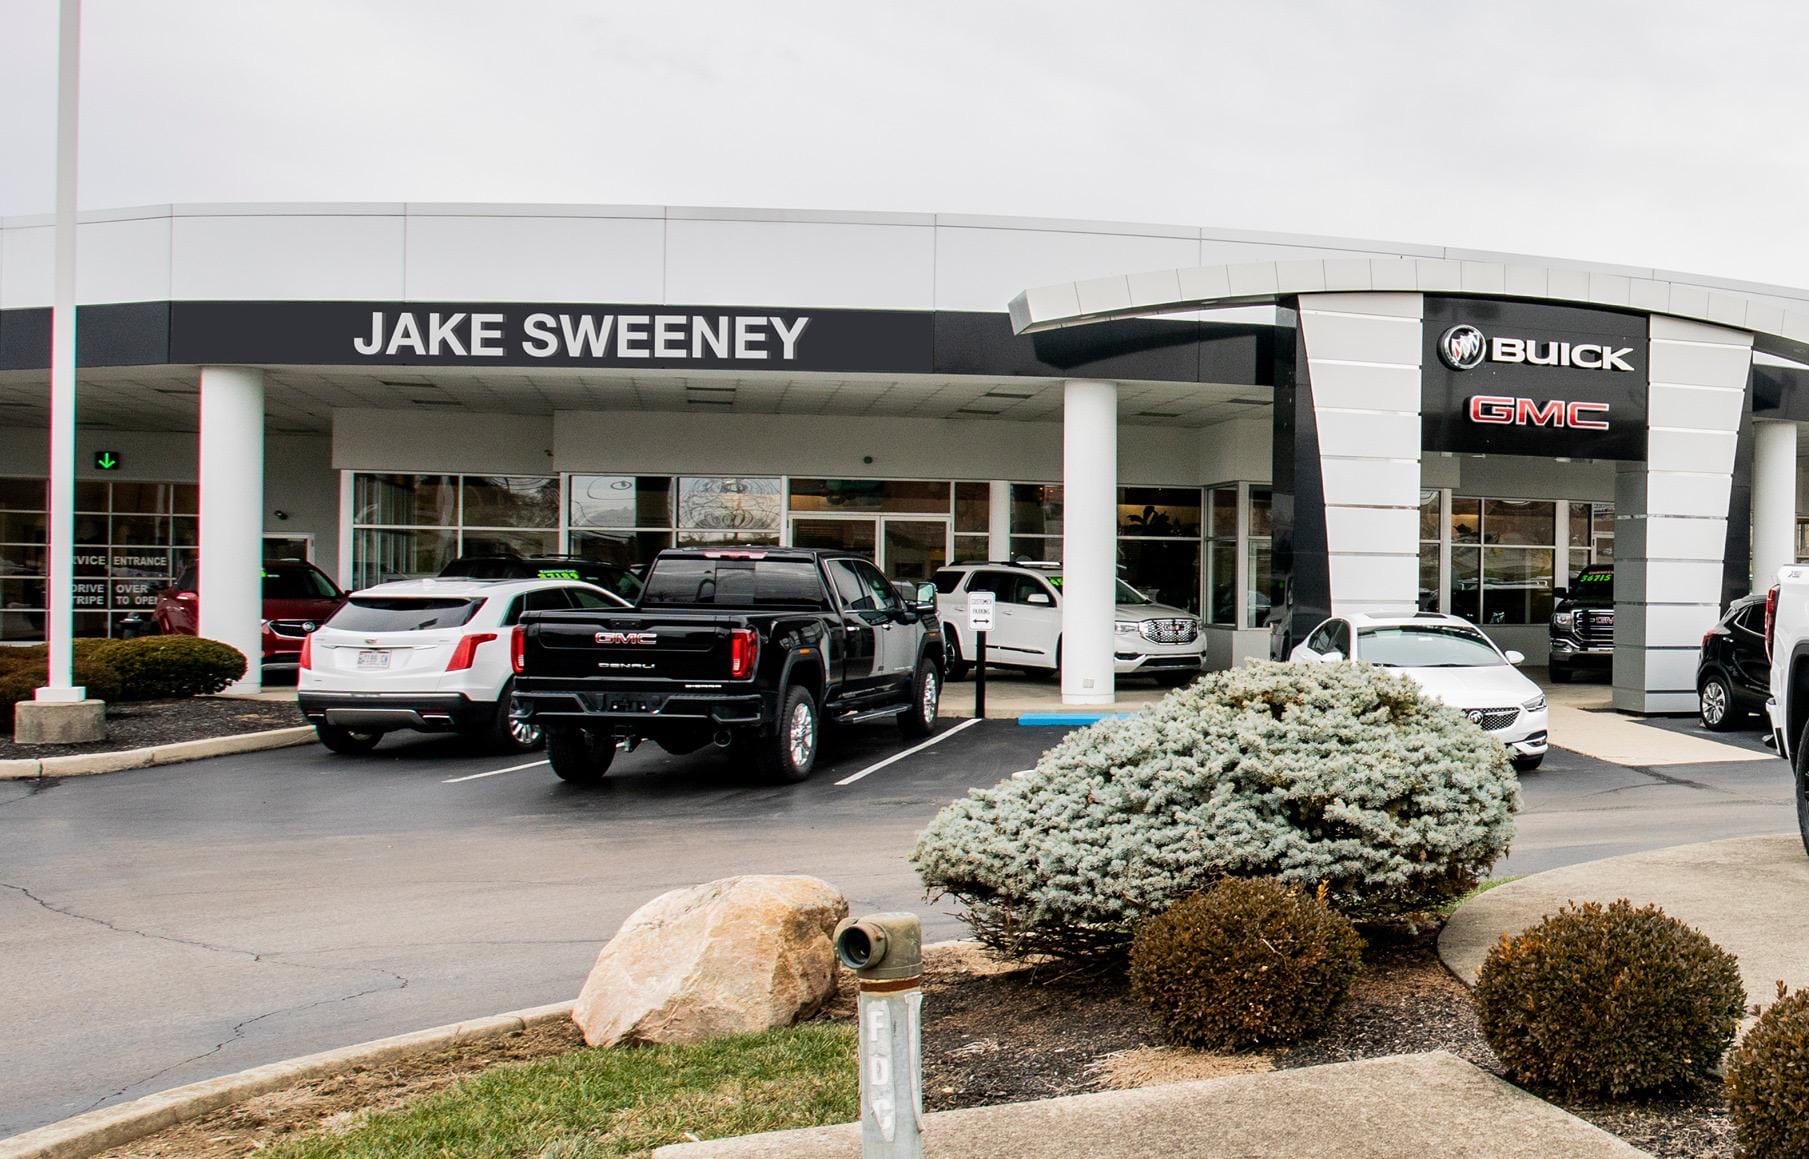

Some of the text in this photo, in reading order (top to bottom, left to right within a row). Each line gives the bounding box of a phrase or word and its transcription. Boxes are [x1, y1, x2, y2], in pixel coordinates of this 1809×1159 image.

[353, 311, 810, 361] JAKE SWEENEY
[1491, 336, 1635, 372] BUICK
[1469, 394, 1610, 431] GMC
[73, 555, 167, 566] VICE ENTRANCE
[115, 584, 148, 593] OVER
[72, 595, 105, 605] RIPE
[115, 595, 130, 605] TO
[594, 631, 657, 645] GMC
